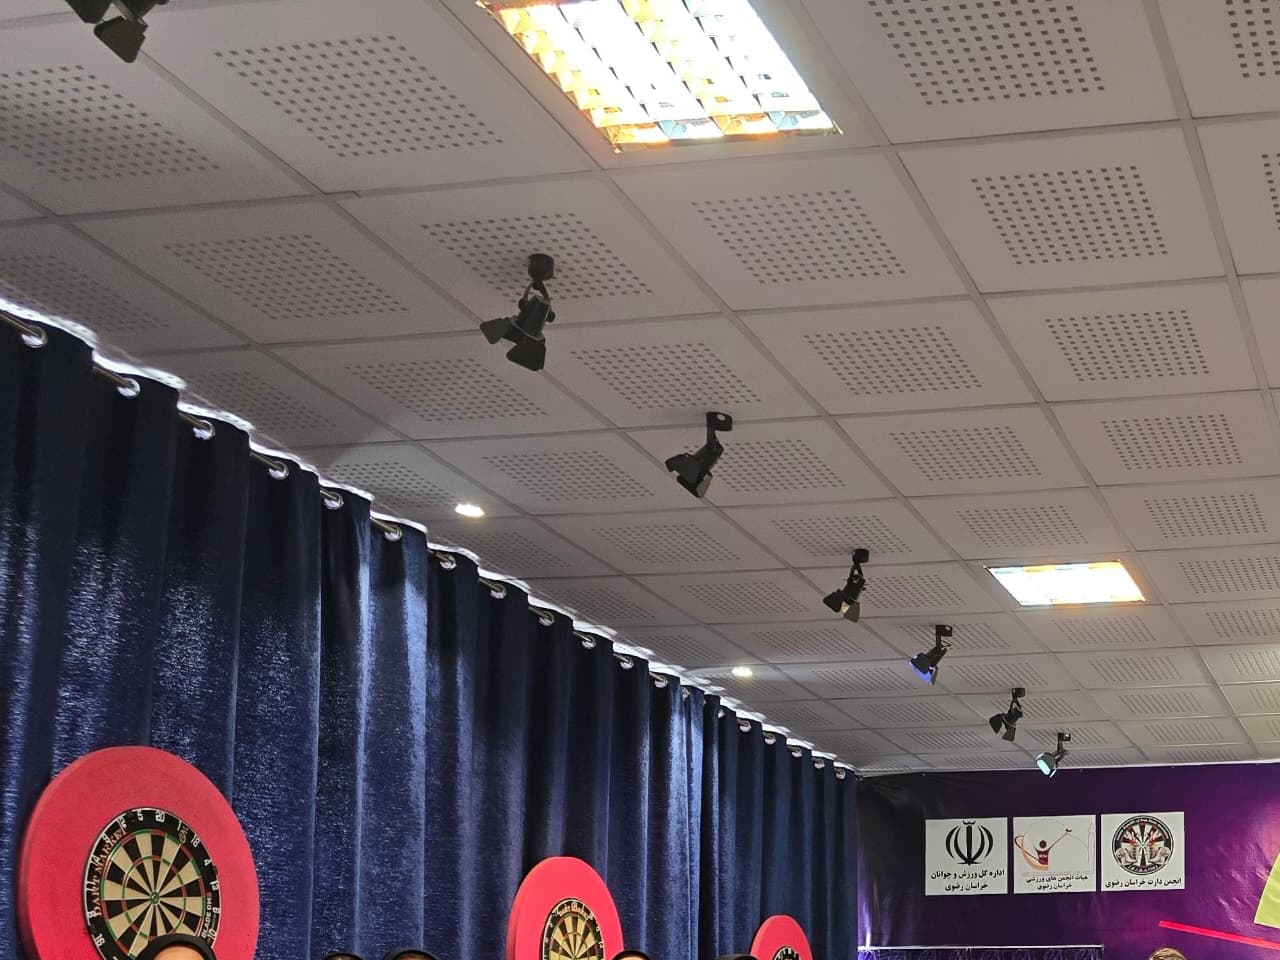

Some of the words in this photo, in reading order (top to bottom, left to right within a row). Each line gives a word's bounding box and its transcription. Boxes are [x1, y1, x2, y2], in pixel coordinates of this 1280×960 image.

[137, 810, 144, 821] 5
[155, 810, 165, 823] 20
[191, 833, 201, 848] 18
[930, 870, 952, 879] جوانان
[959, 870, 978, 879] ورزش
[978, 870, 988, 878] کل
[989, 869, 1005, 878] اداره
[965, 882, 988, 890] خراسان
[1053, 882, 1072, 890] خراسان
[1105, 880, 1123, 888] رضوی
[1125, 878, 1145, 887] خراسان
[1148, 878, 1162, 886] دارت
[1164, 878, 1181, 886] انجمن
[944, 882, 964, 892] رضوی
